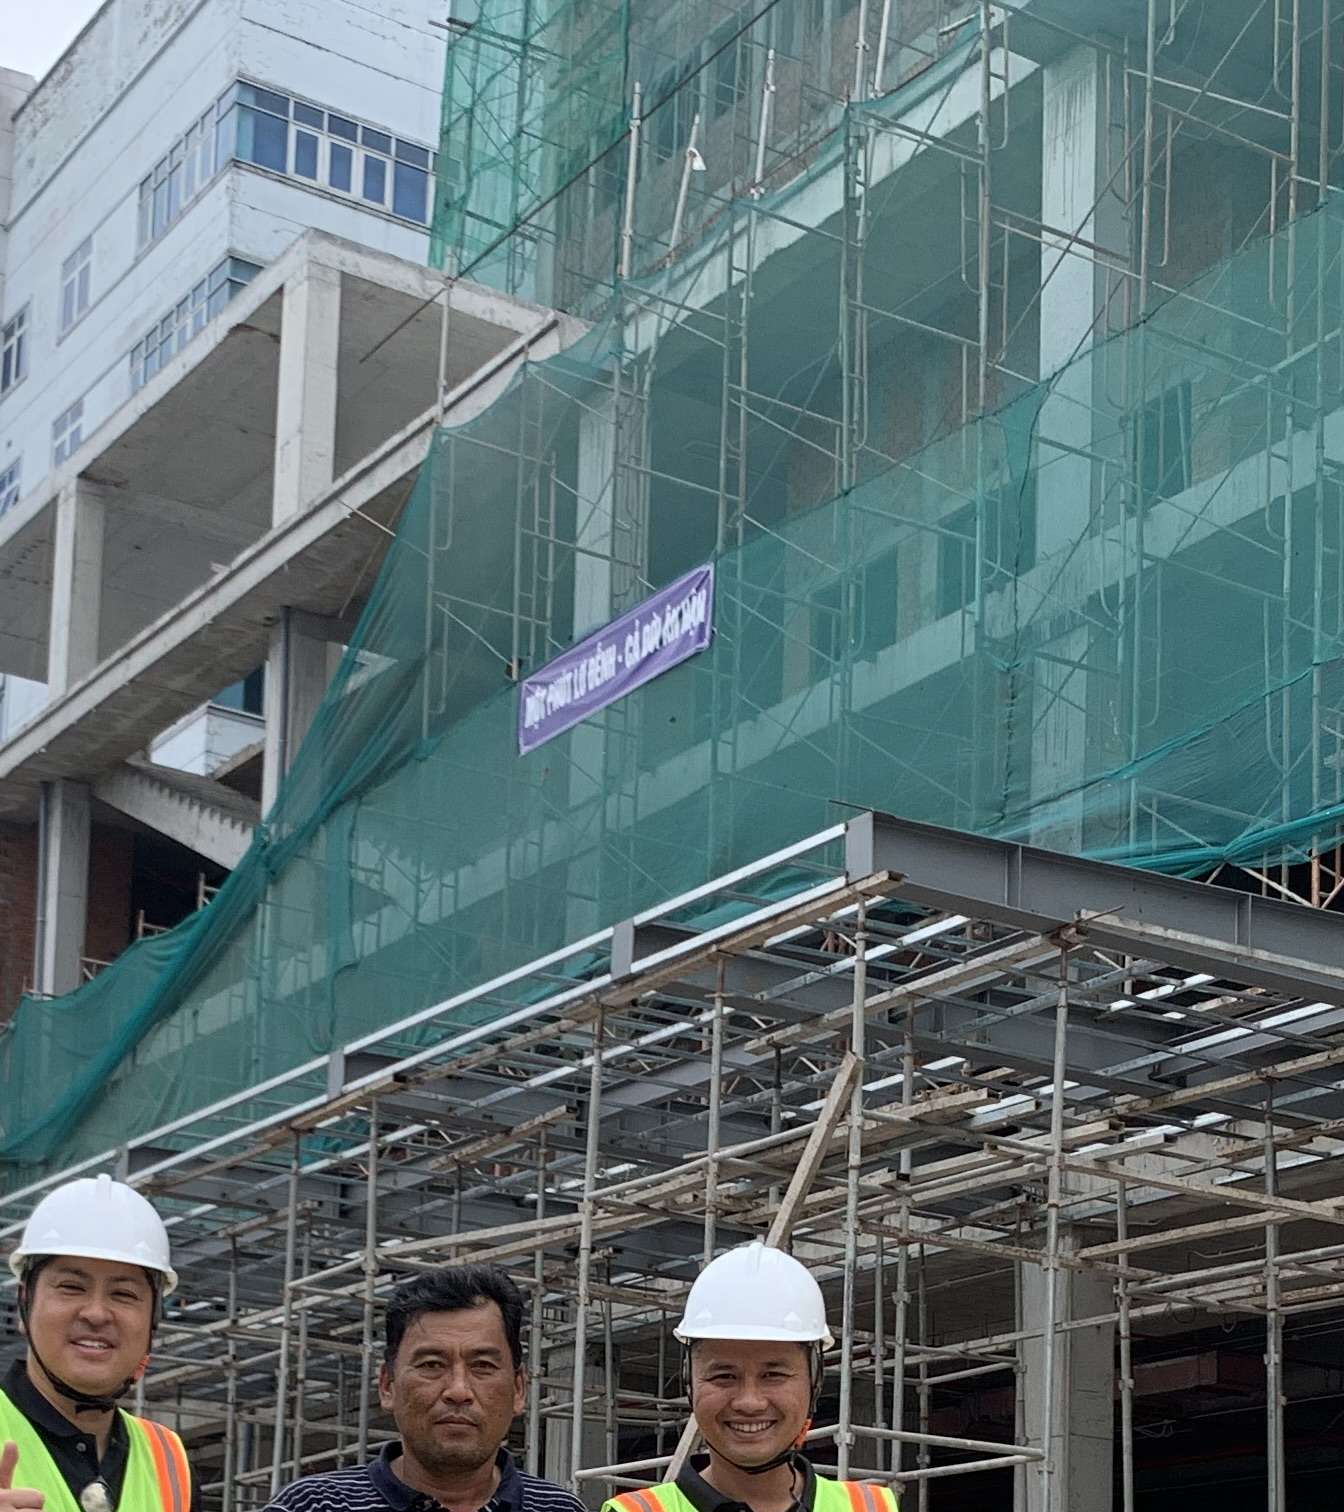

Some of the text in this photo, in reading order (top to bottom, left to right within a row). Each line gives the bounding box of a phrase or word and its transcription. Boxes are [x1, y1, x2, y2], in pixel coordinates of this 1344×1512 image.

[524, 685, 546, 730] MỘT
[547, 669, 572, 716] PHÚT
[573, 659, 587, 700] LƠ
[625, 619, 640, 669] CẢ
[641, 612, 662, 657] ĐỜI
[662, 604, 679, 645] ÂN
[679, 588, 707, 637] HẬN
